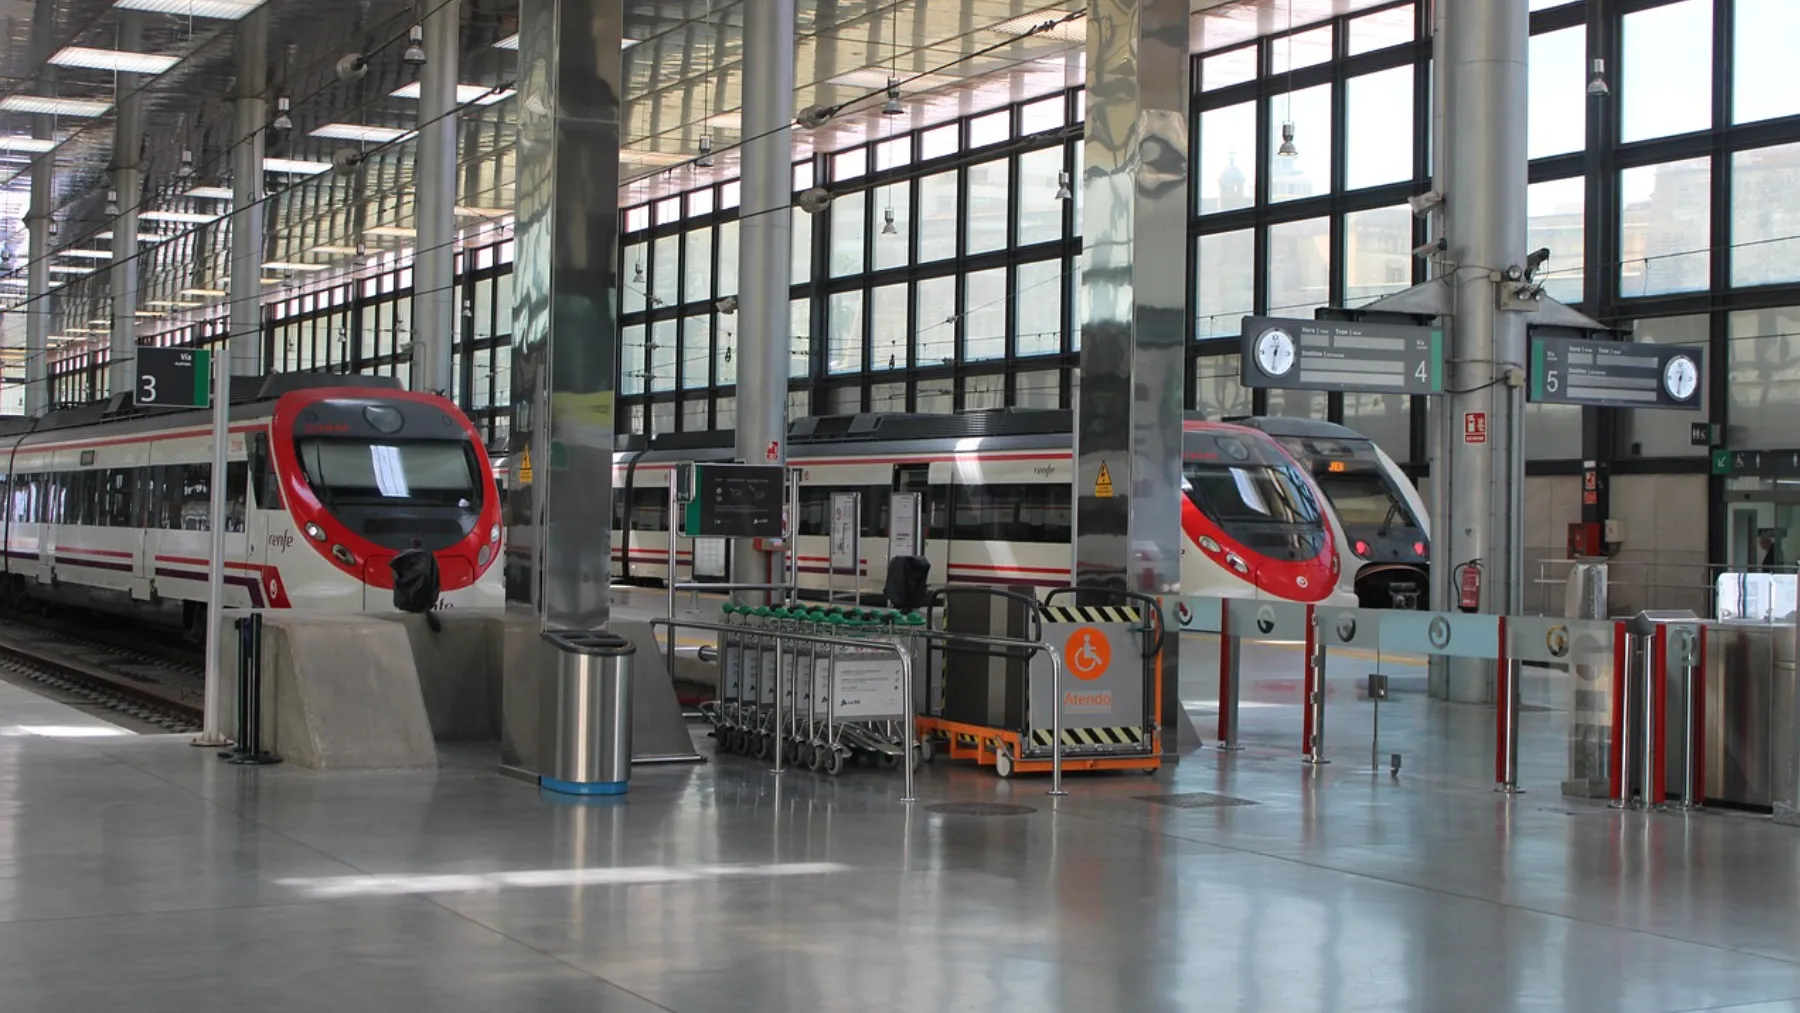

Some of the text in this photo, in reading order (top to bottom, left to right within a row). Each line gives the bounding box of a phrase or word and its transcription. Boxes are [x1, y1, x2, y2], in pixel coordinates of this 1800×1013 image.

[1414, 360, 1428, 383] 4
[1546, 370, 1558, 393] 5
[141, 375, 157, 402] 3
[1033, 464, 1055, 477] renfe
[268, 529, 294, 553] renfe
[1064, 692, 1111, 706] Atendo
